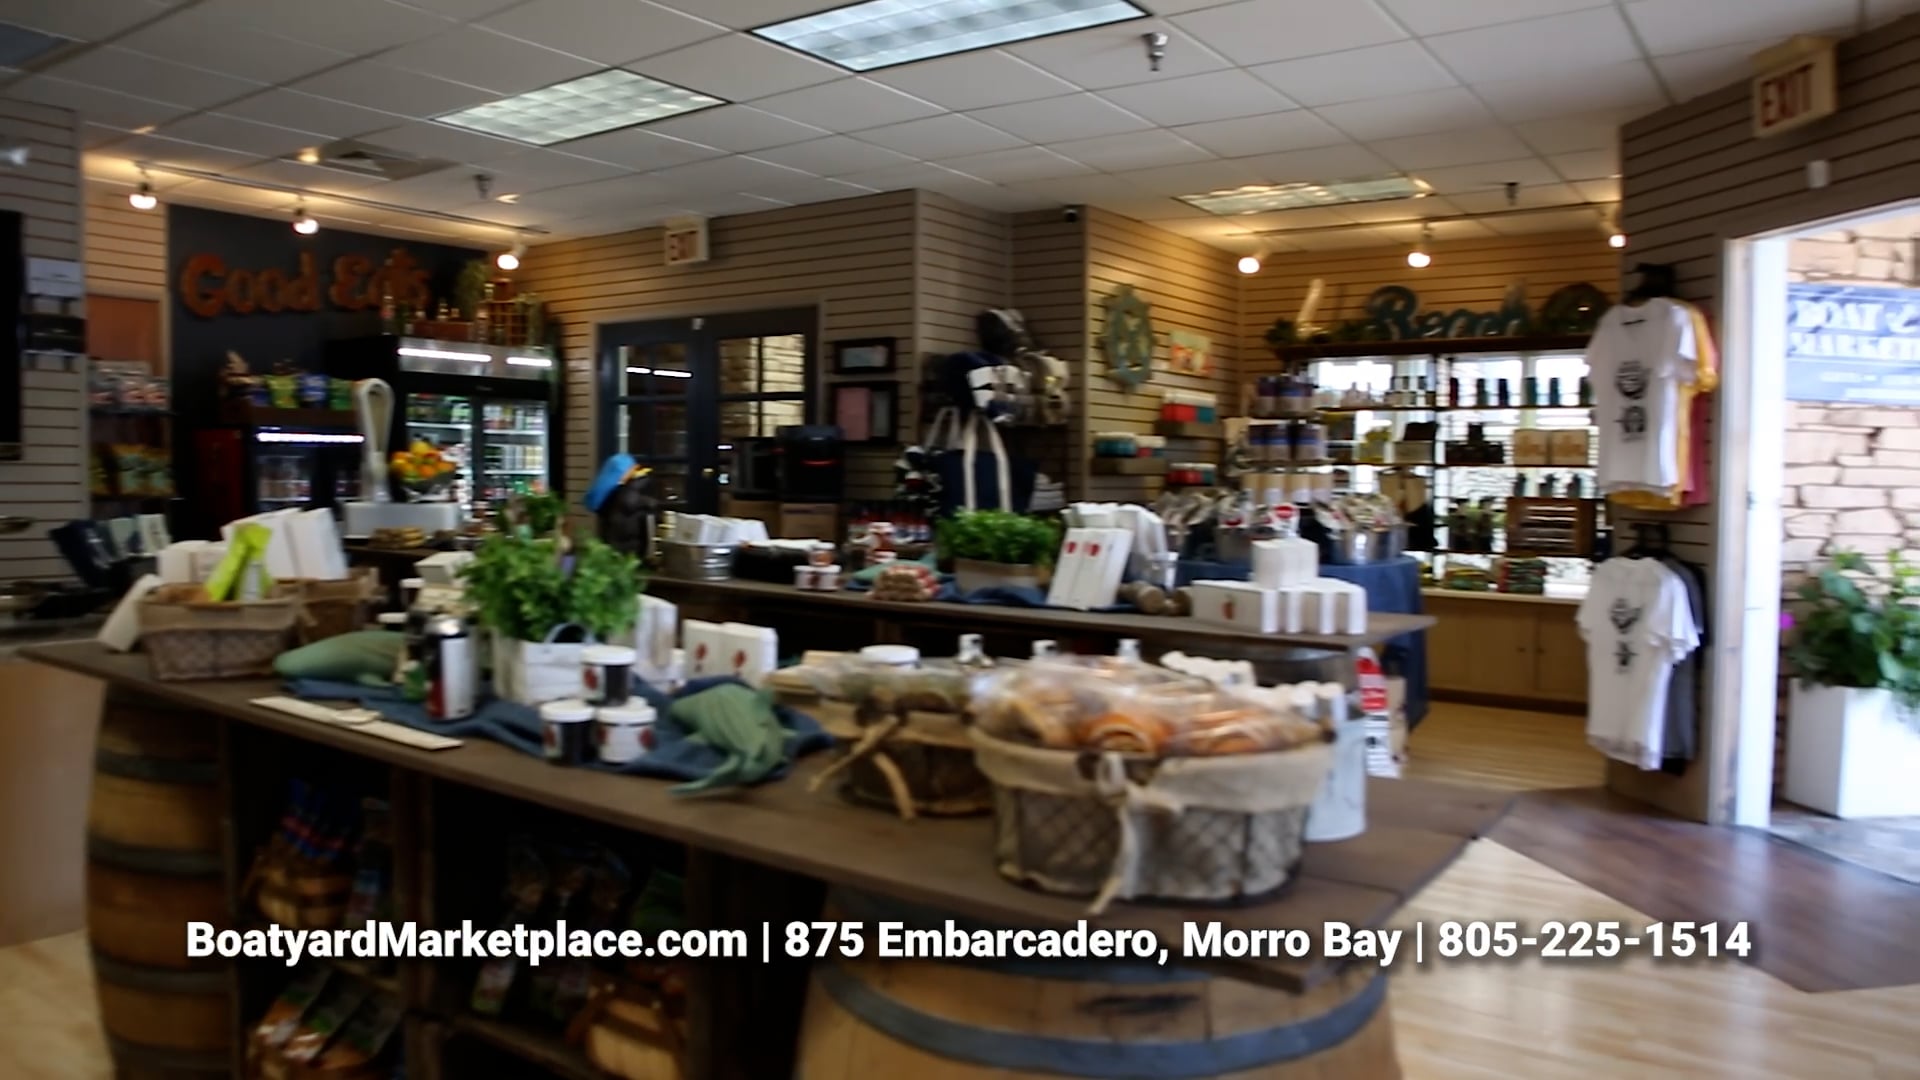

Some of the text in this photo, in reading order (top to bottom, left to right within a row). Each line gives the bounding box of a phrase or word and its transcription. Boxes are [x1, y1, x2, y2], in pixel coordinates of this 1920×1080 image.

[1760, 63, 1816, 129] EXIT
[180, 248, 430, 319] Good Eats
